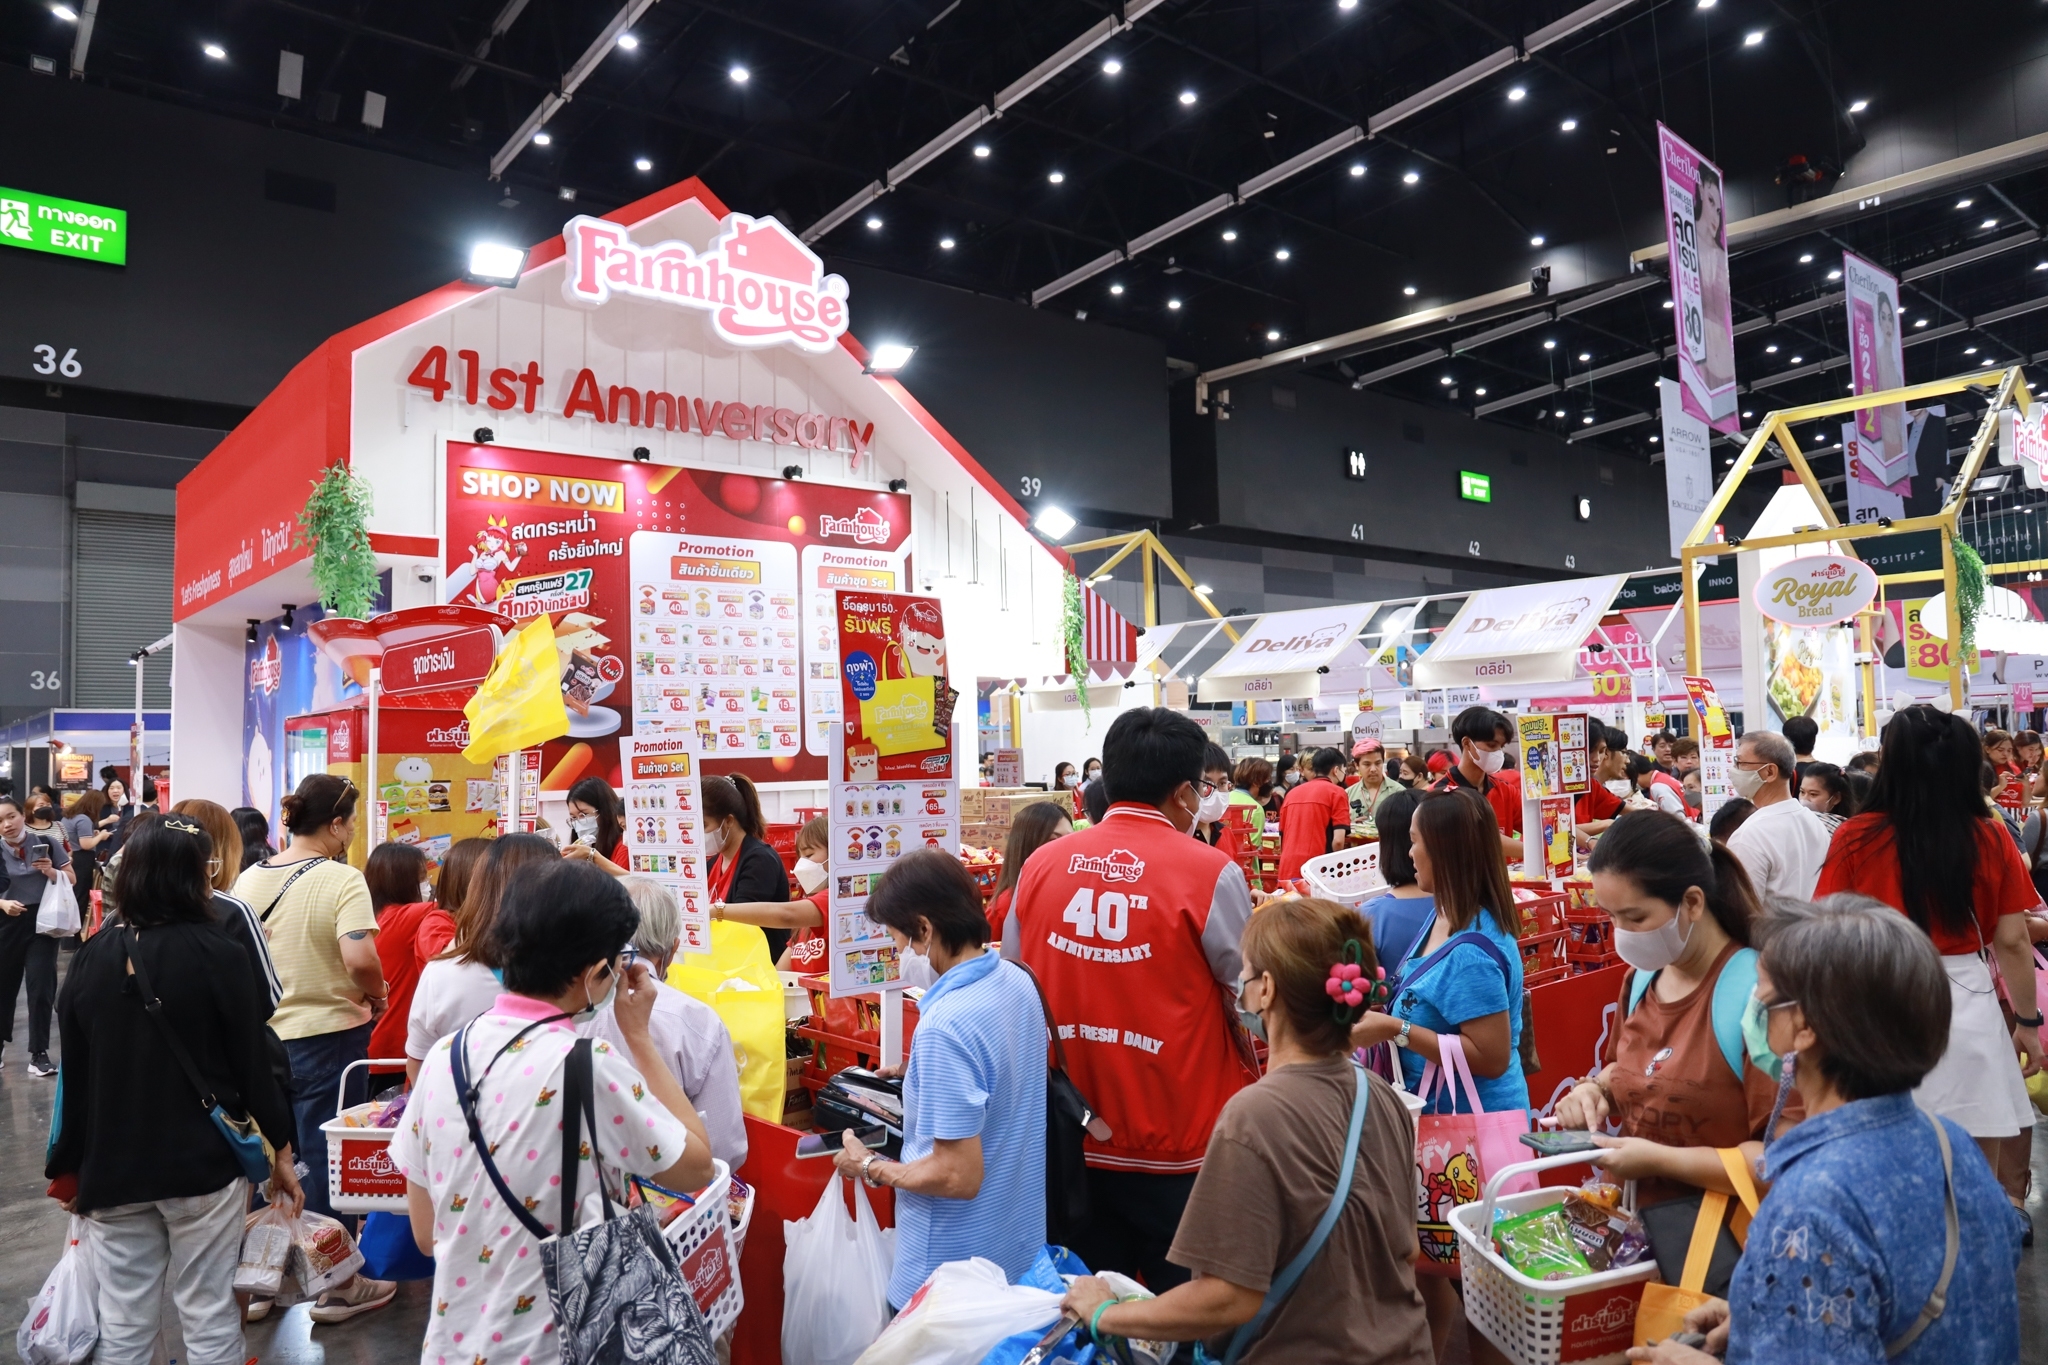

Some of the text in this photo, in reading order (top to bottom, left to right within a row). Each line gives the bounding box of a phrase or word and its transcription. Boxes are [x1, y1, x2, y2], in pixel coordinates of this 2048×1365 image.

[1663, 140, 1701, 184] Cherilon
[38, 205, 117, 233] ทางออก
[50, 228, 104, 253] EXIT
[577, 222, 843, 343] Farmhouse
[1849, 266, 1880, 296] Cherilon
[33, 344, 82, 378] 36
[1862, 351, 1871, 380] 2
[408, 346, 874, 469] 41st Anniversary
[1671, 427, 1702, 444] ARROW
[462, 471, 617, 506] SHOP NOW
[1021, 476, 1042, 497] 39
[511, 511, 597, 540] สดกระหน่ำ
[820, 511, 891, 544] Farmhouse
[1351, 523, 1364, 540] 41
[549, 537, 623, 561] ครั้งยิ่งใหญ่
[678, 541, 754, 558] Promotion
[1469, 540, 1480, 556] 42
[822, 552, 888, 568] Promotion
[1565, 555, 1575, 569] 43
[678, 562, 755, 580] สินค้าชิ้นเดียว
[565, 570, 592, 591] 27
[826, 571, 888, 589] สินค้าชุด Set
[1708, 576, 1733, 587] INNO
[1771, 573, 1859, 607] Royal
[669, 603, 682, 613] 40
[725, 605, 736, 615] 40
[777, 608, 788, 617] 40
[1798, 603, 1833, 618] Bread
[661, 635, 670, 643] 35
[703, 636, 712, 644] 40
[743, 638, 752, 646] 45
[782, 639, 790, 647] 50
[1245, 635, 1335, 653] Deliya
[413, 646, 455, 682] จุดชำระเงิน
[662, 666, 668, 674] 9
[704, 666, 712, 674] 10
[744, 666, 752, 674] 10
[846, 660, 874, 675] ถุงผ้า
[1475, 660, 1512, 676] เดลิย่า
[30, 670, 61, 691] 36
[1244, 678, 1273, 691] เดลิย่า
[671, 699, 682, 709] 13
[727, 700, 737, 709] 15
[779, 700, 789, 709] 15
[875, 697, 928, 724] Farmhouse
[779, 735, 789, 744] 15
[1354, 726, 1379, 738] Deliya
[634, 739, 683, 753] Promotion
[727, 736, 737, 745] 15
[638, 762, 684, 777] สินค้าชุด Set
[926, 803, 938, 811] 165
[1068, 852, 1145, 882] Farmhouse
[1047, 931, 1152, 963] ANNIVERSARY
[1079, 1023, 1118, 1043] FRESH
[1123, 1030, 1164, 1055] DAILY
